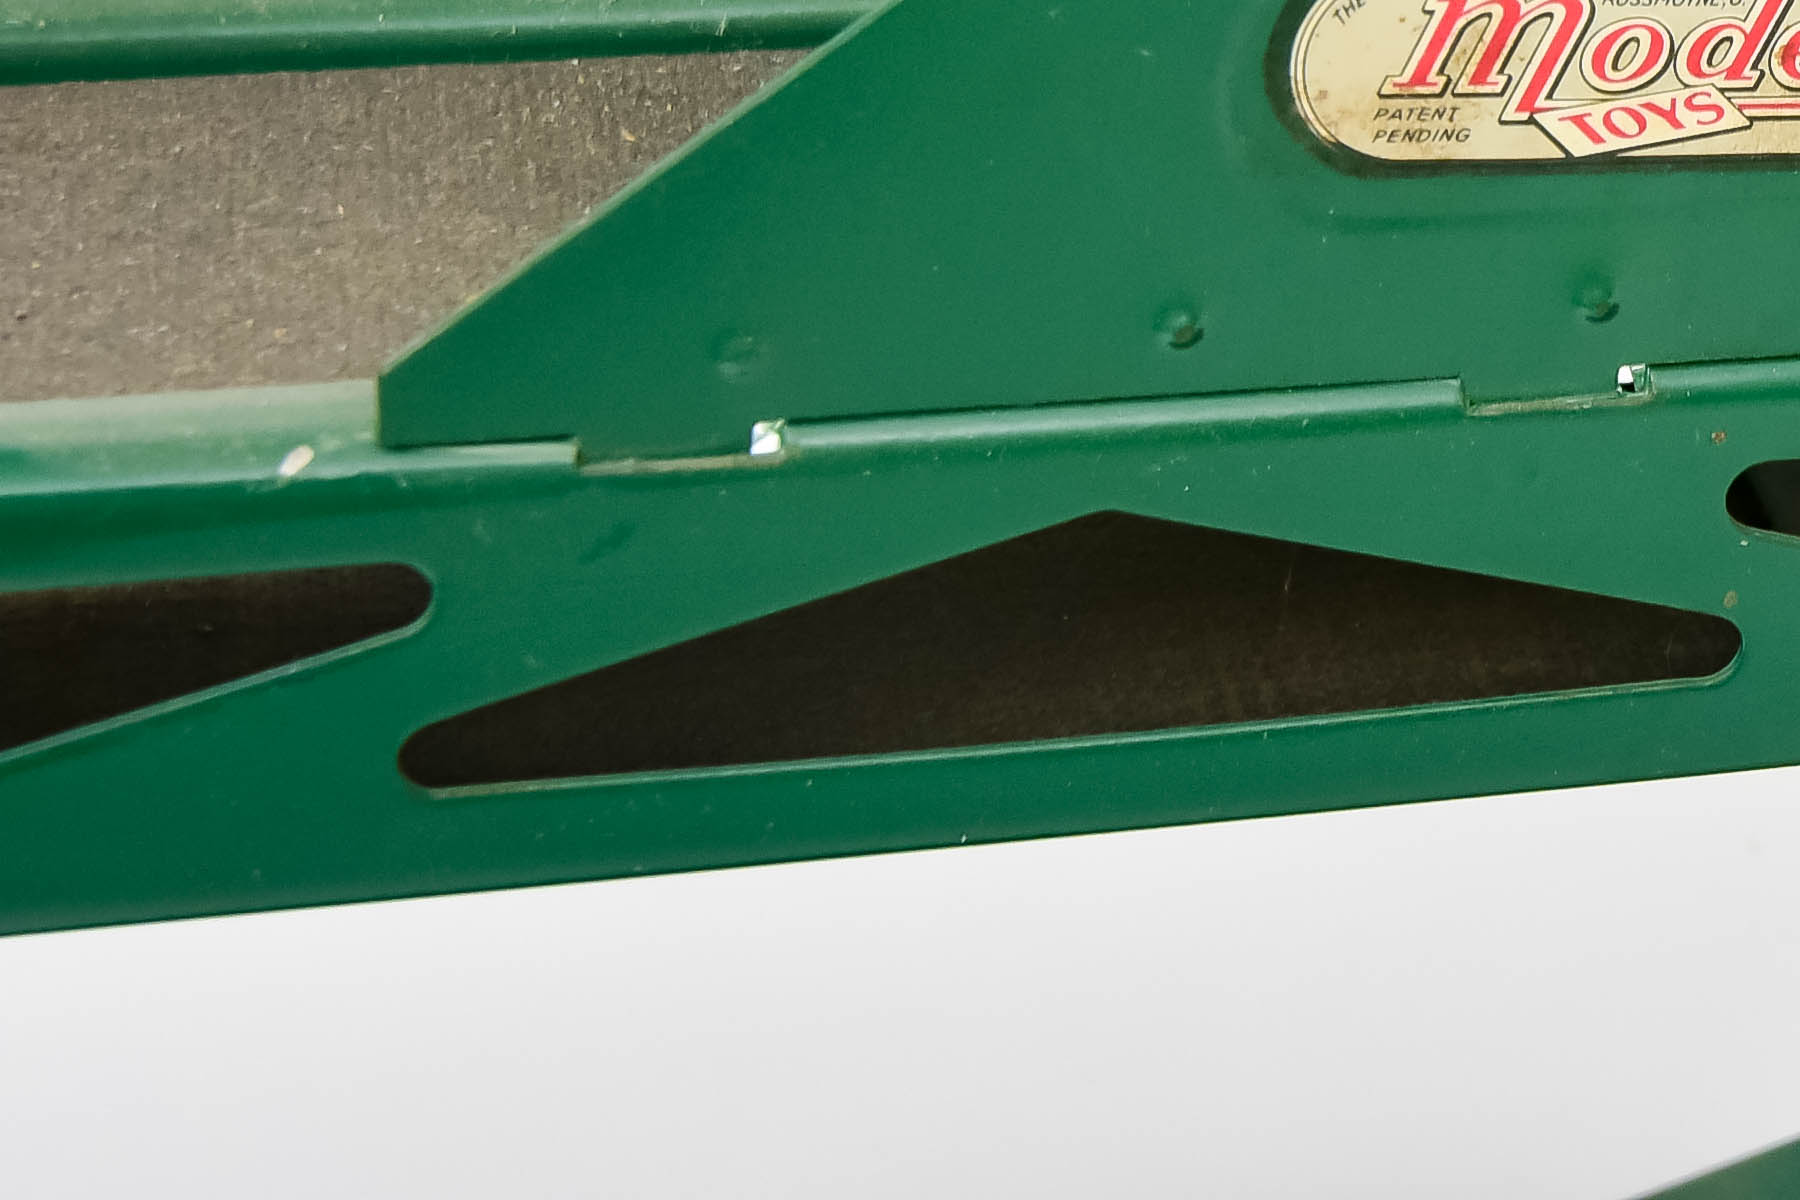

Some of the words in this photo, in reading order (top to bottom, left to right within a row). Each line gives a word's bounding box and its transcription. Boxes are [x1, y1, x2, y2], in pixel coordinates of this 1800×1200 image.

[1372, 106, 1461, 122] PATENT
[1557, 91, 1726, 146] TOYS
[1371, 127, 1472, 144] PENDING
